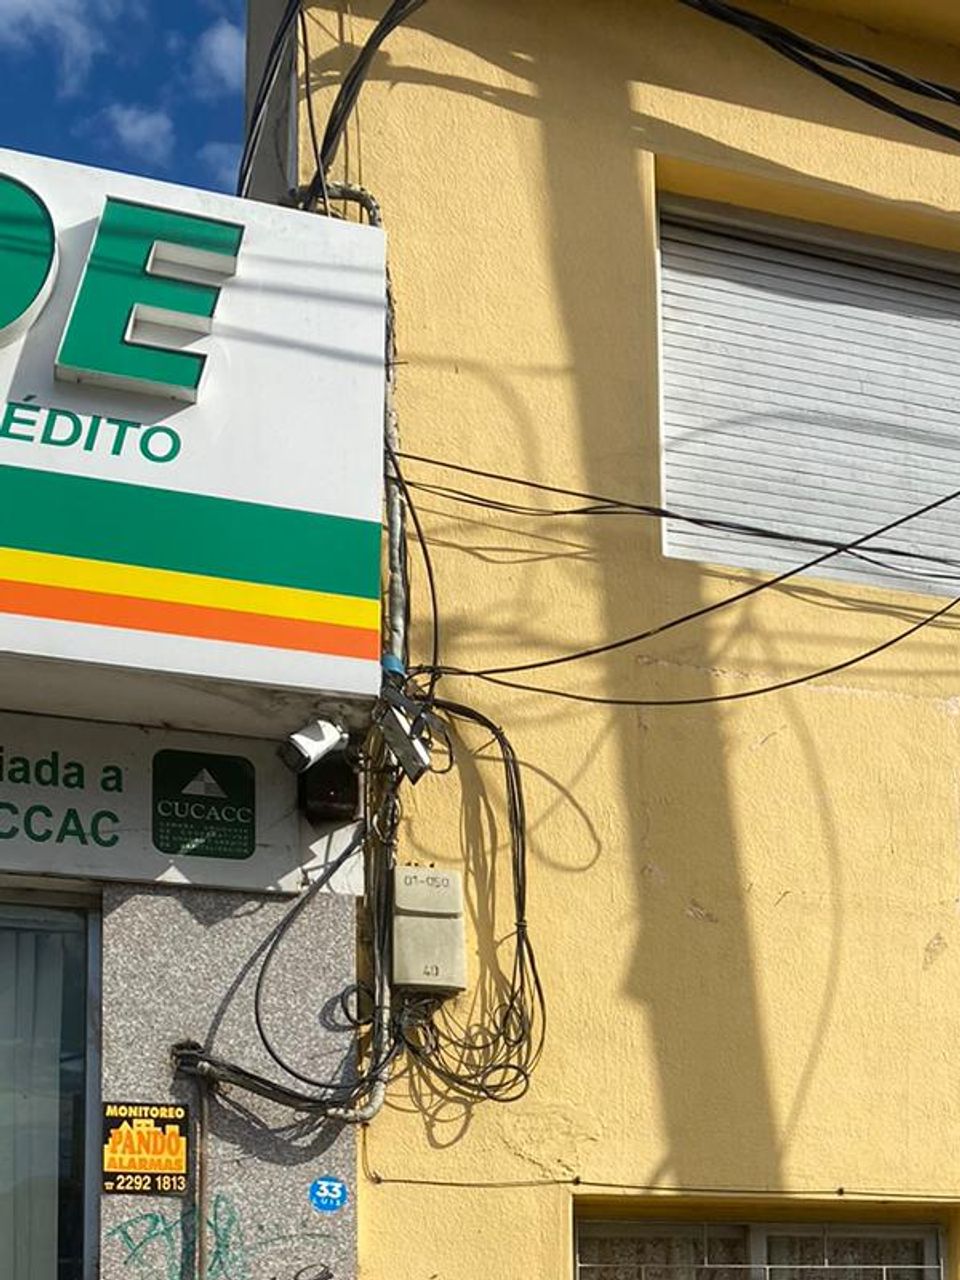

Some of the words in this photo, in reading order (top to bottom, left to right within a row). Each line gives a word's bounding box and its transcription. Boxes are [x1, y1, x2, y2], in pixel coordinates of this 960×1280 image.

[100, 764, 123, 793] a
[157, 800, 253, 823] CUCACC
[105, 1104, 186, 1120] MONITOREO
[109, 1129, 182, 1157] PANDO
[107, 1156, 184, 1171] ALARMAS
[116, 1174, 152, 1191] 2292
[156, 1175, 187, 1192] 1813
[316, 1180, 343, 1199] 33
